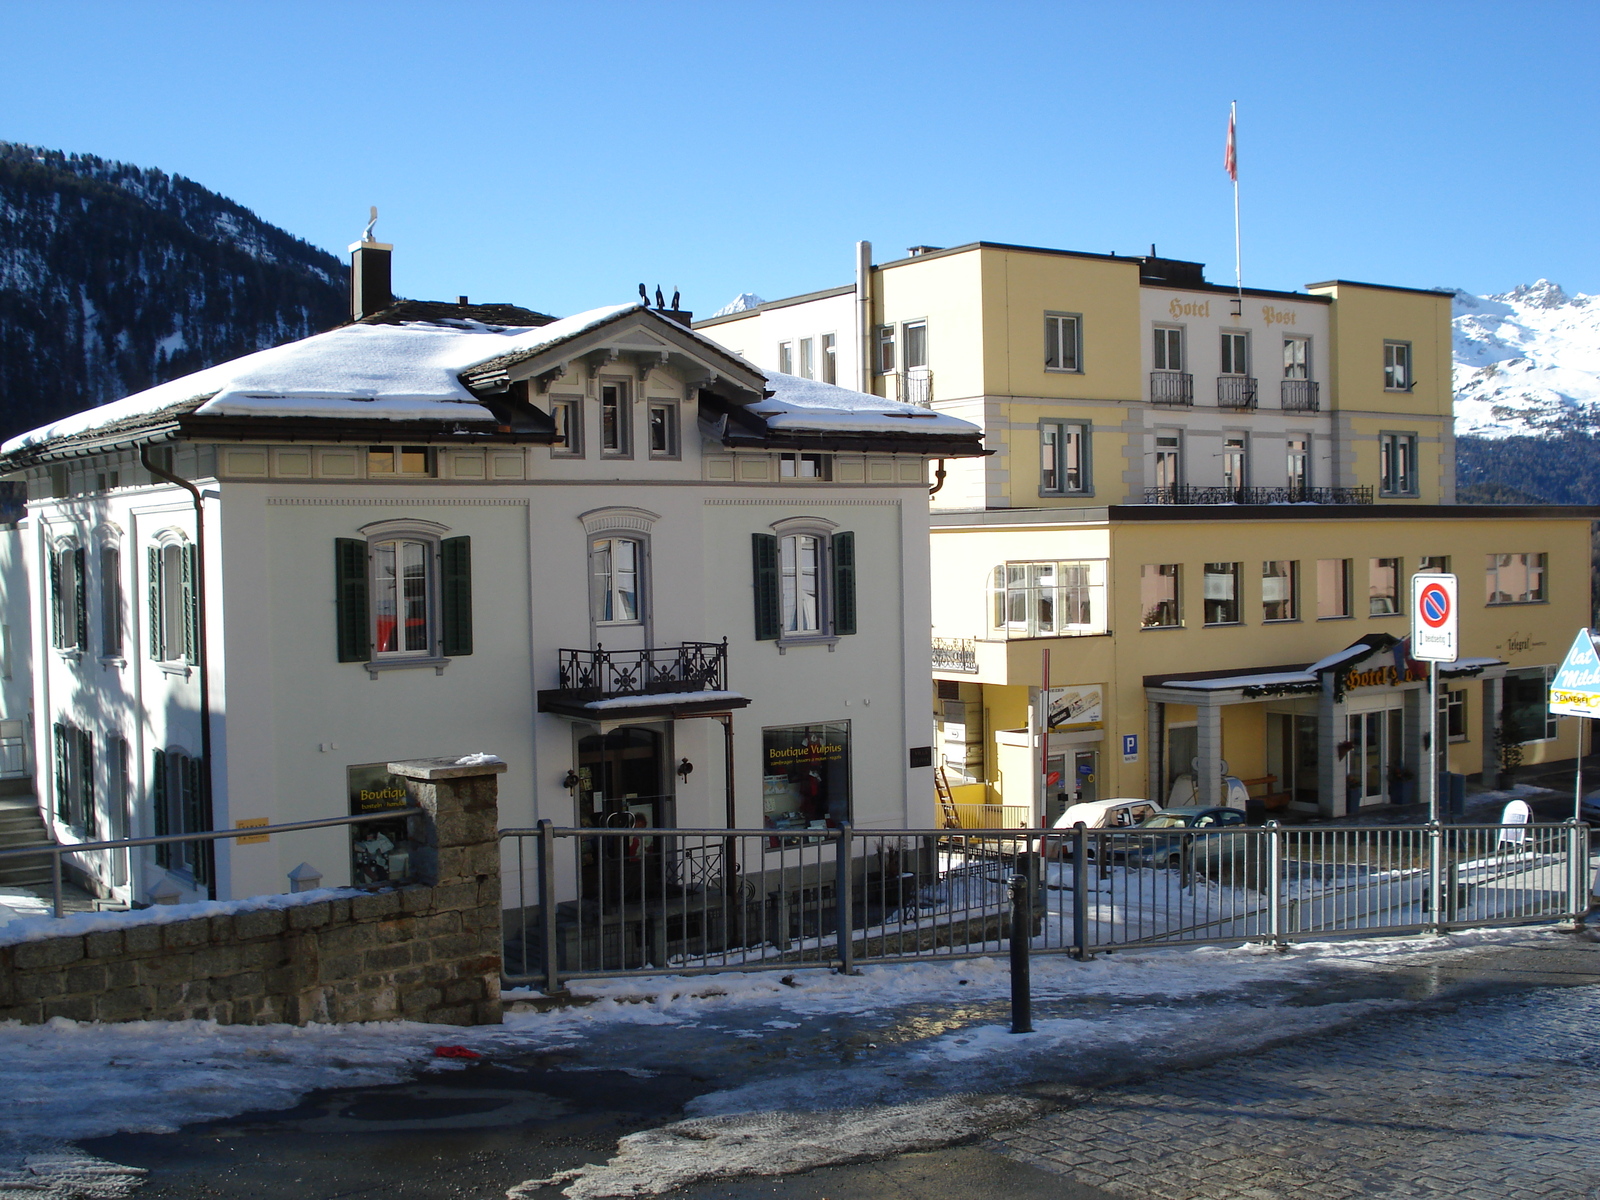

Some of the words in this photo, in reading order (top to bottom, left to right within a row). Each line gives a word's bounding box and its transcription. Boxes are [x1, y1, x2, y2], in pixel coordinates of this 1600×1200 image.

[1169, 298, 1210, 320] Hotel
[1261, 305, 1297, 327] Post
[1347, 665, 1388, 691] Hotel
[769, 746, 809, 759] Boutique
[811, 742, 842, 756] Vulpius
[1126, 737, 1135, 753] P
[360, 787, 406, 800] Boutiqu
